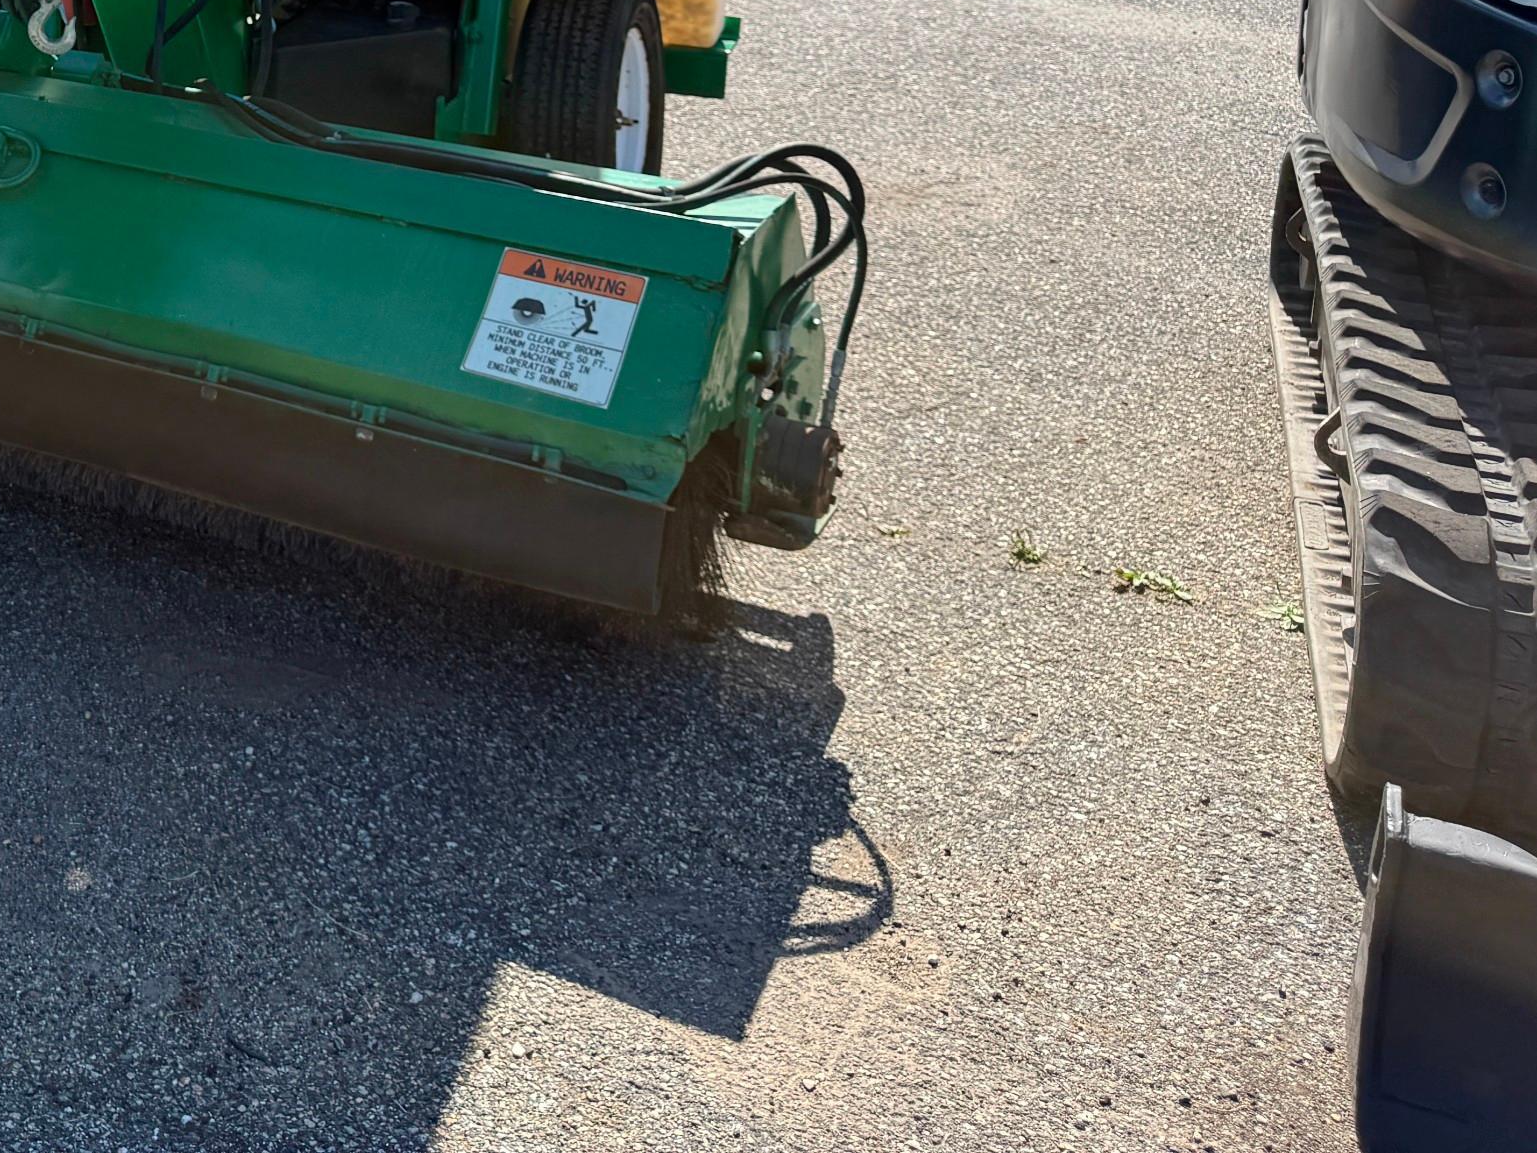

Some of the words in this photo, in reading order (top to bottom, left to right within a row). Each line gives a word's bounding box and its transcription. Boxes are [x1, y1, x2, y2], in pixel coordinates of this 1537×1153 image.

[554, 268, 628, 296] WARNING
[487, 333, 525, 347] MINIMUM
[528, 343, 573, 360] DISTANCE
[577, 355, 589, 364] 50
[496, 325, 524, 338] STAND
[527, 332, 556, 346] CLEAR
[558, 341, 571, 349] OF
[494, 344, 516, 356] WHEN
[519, 350, 559, 367] MACHINE
[563, 361, 575, 370] IS
[578, 366, 590, 374] IN
[505, 356, 555, 375] OPERATION
[559, 370, 572, 379] OR
[487, 360, 521, 377] ENGINE
[524, 370, 535, 380] IS
[539, 374, 578, 392] RUNNING
